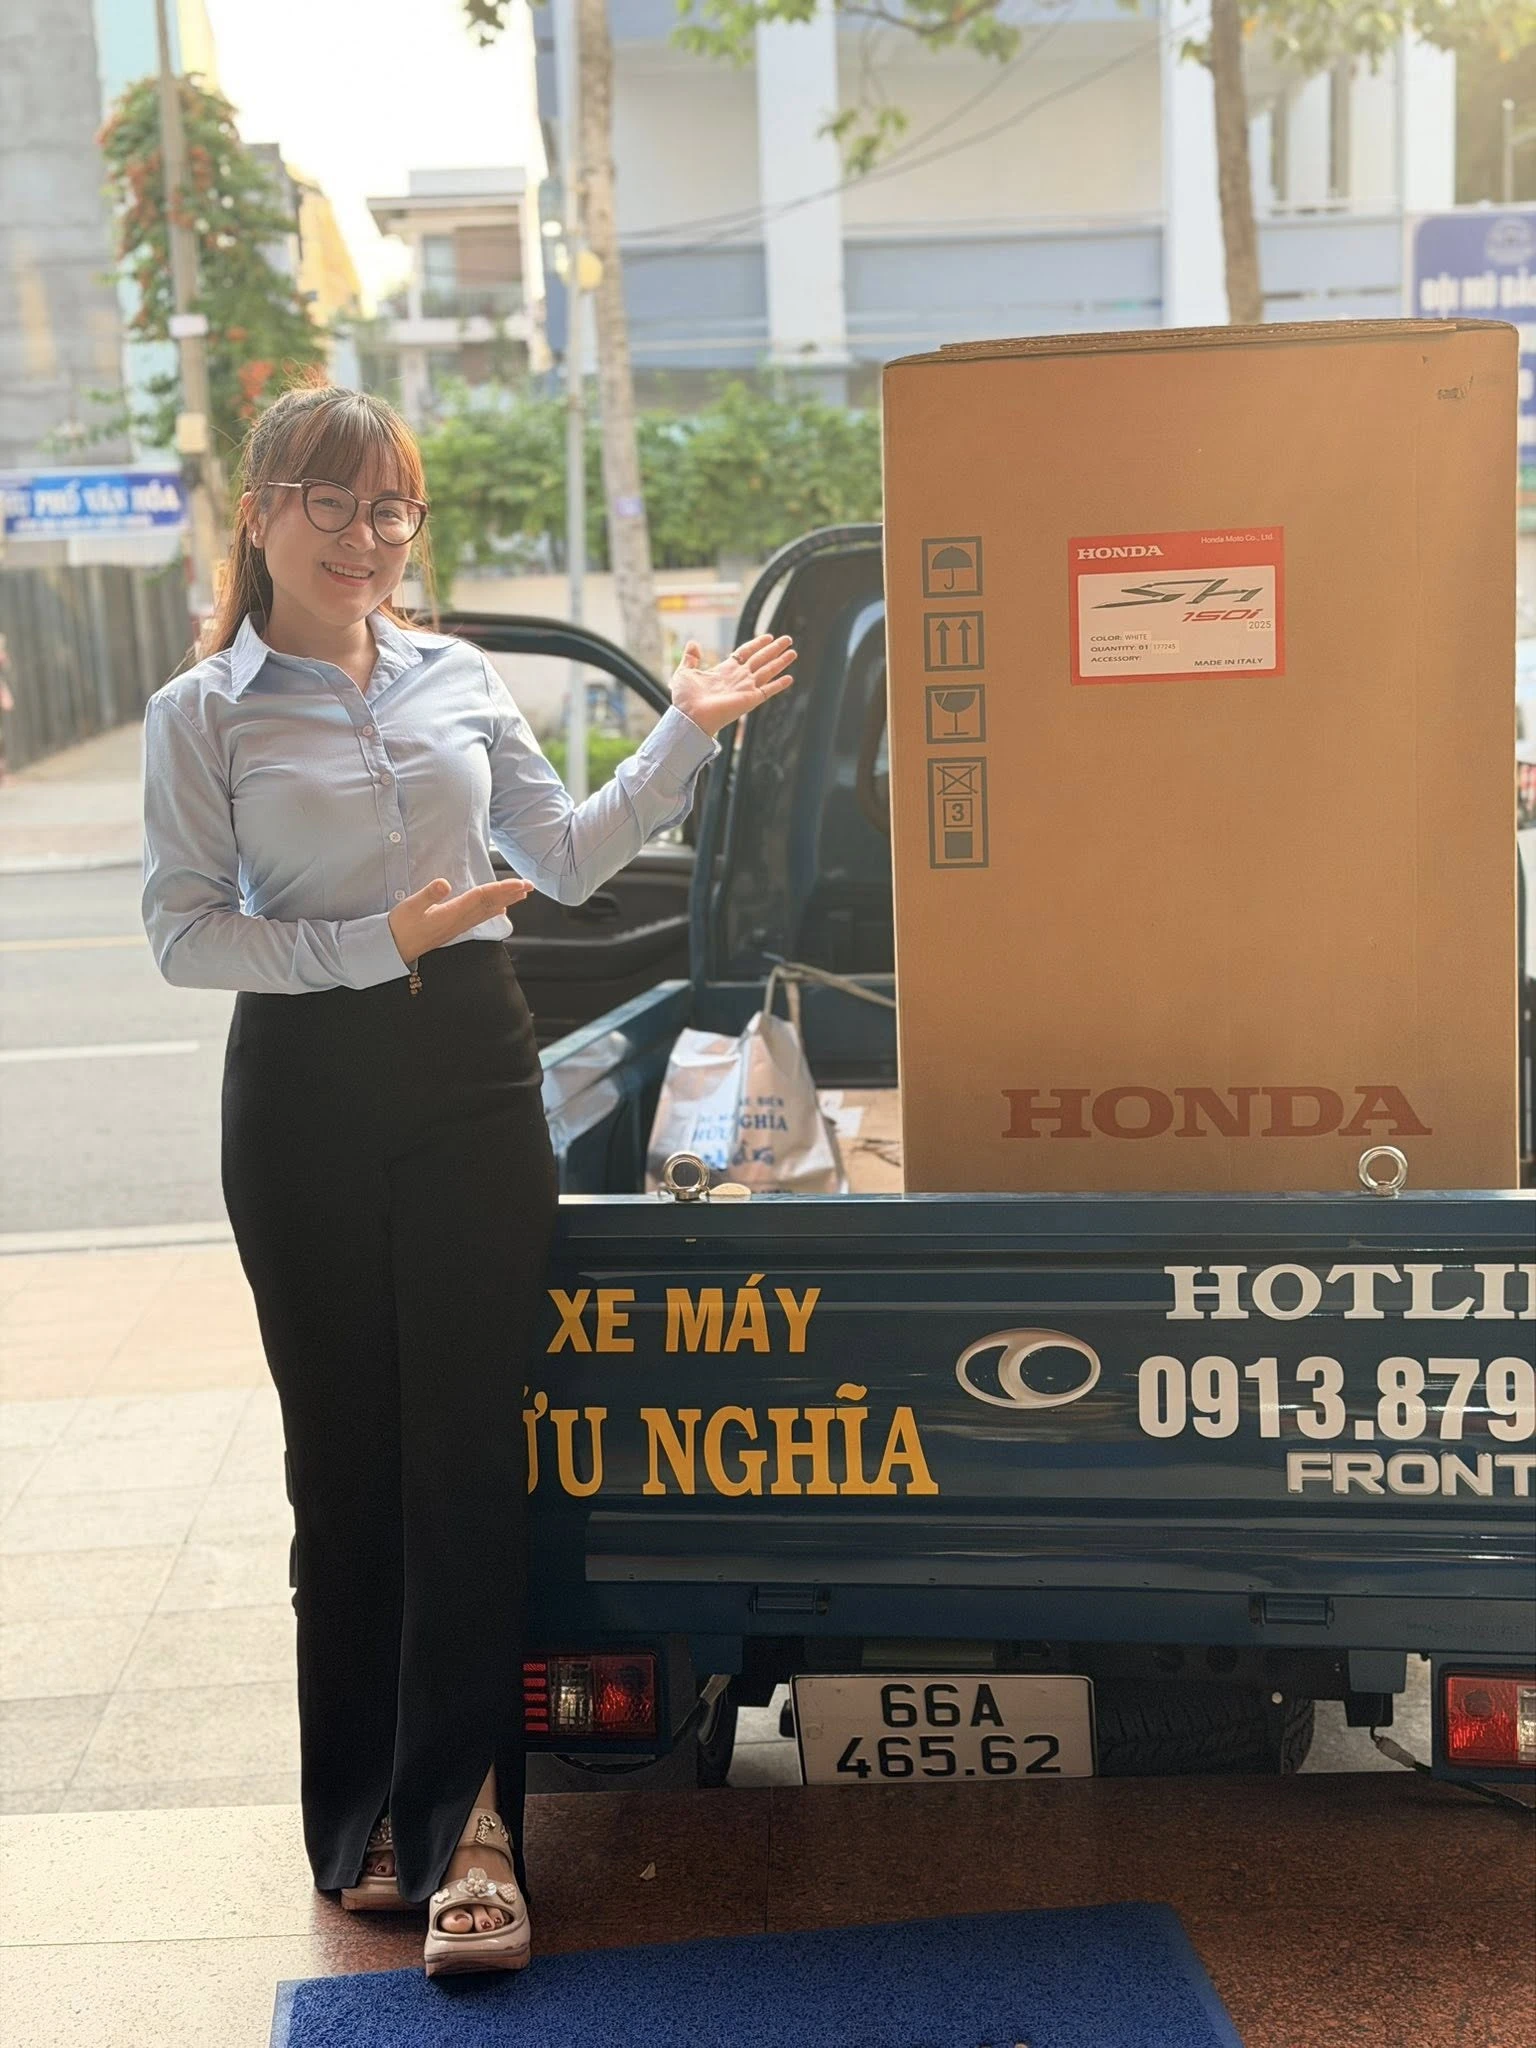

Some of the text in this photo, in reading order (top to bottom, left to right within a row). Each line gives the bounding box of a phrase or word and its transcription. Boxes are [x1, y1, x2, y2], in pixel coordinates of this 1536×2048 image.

[1077, 545, 1164, 560] HONDA
[1201, 536, 1224, 544] Honda
[1182, 608, 1263, 622] 150i
[1248, 620, 1272, 630] 2025
[1125, 633, 1147, 641] WHITE
[1194, 659, 1222, 667] MADE
[1237, 657, 1263, 665] ITALY
[951, 805, 964, 822] 3
[1001, 1085, 1433, 1139] HONDA
[1163, 1262, 1536, 1321] HOTLI
[547, 1272, 822, 1354] XE MÁY
[640, 1382, 940, 1497] NGHĨA
[1287, 1449, 1536, 1497] FRONT
[880, 1683, 1005, 1728] 66A
[836, 1734, 1062, 1778] 465.62
